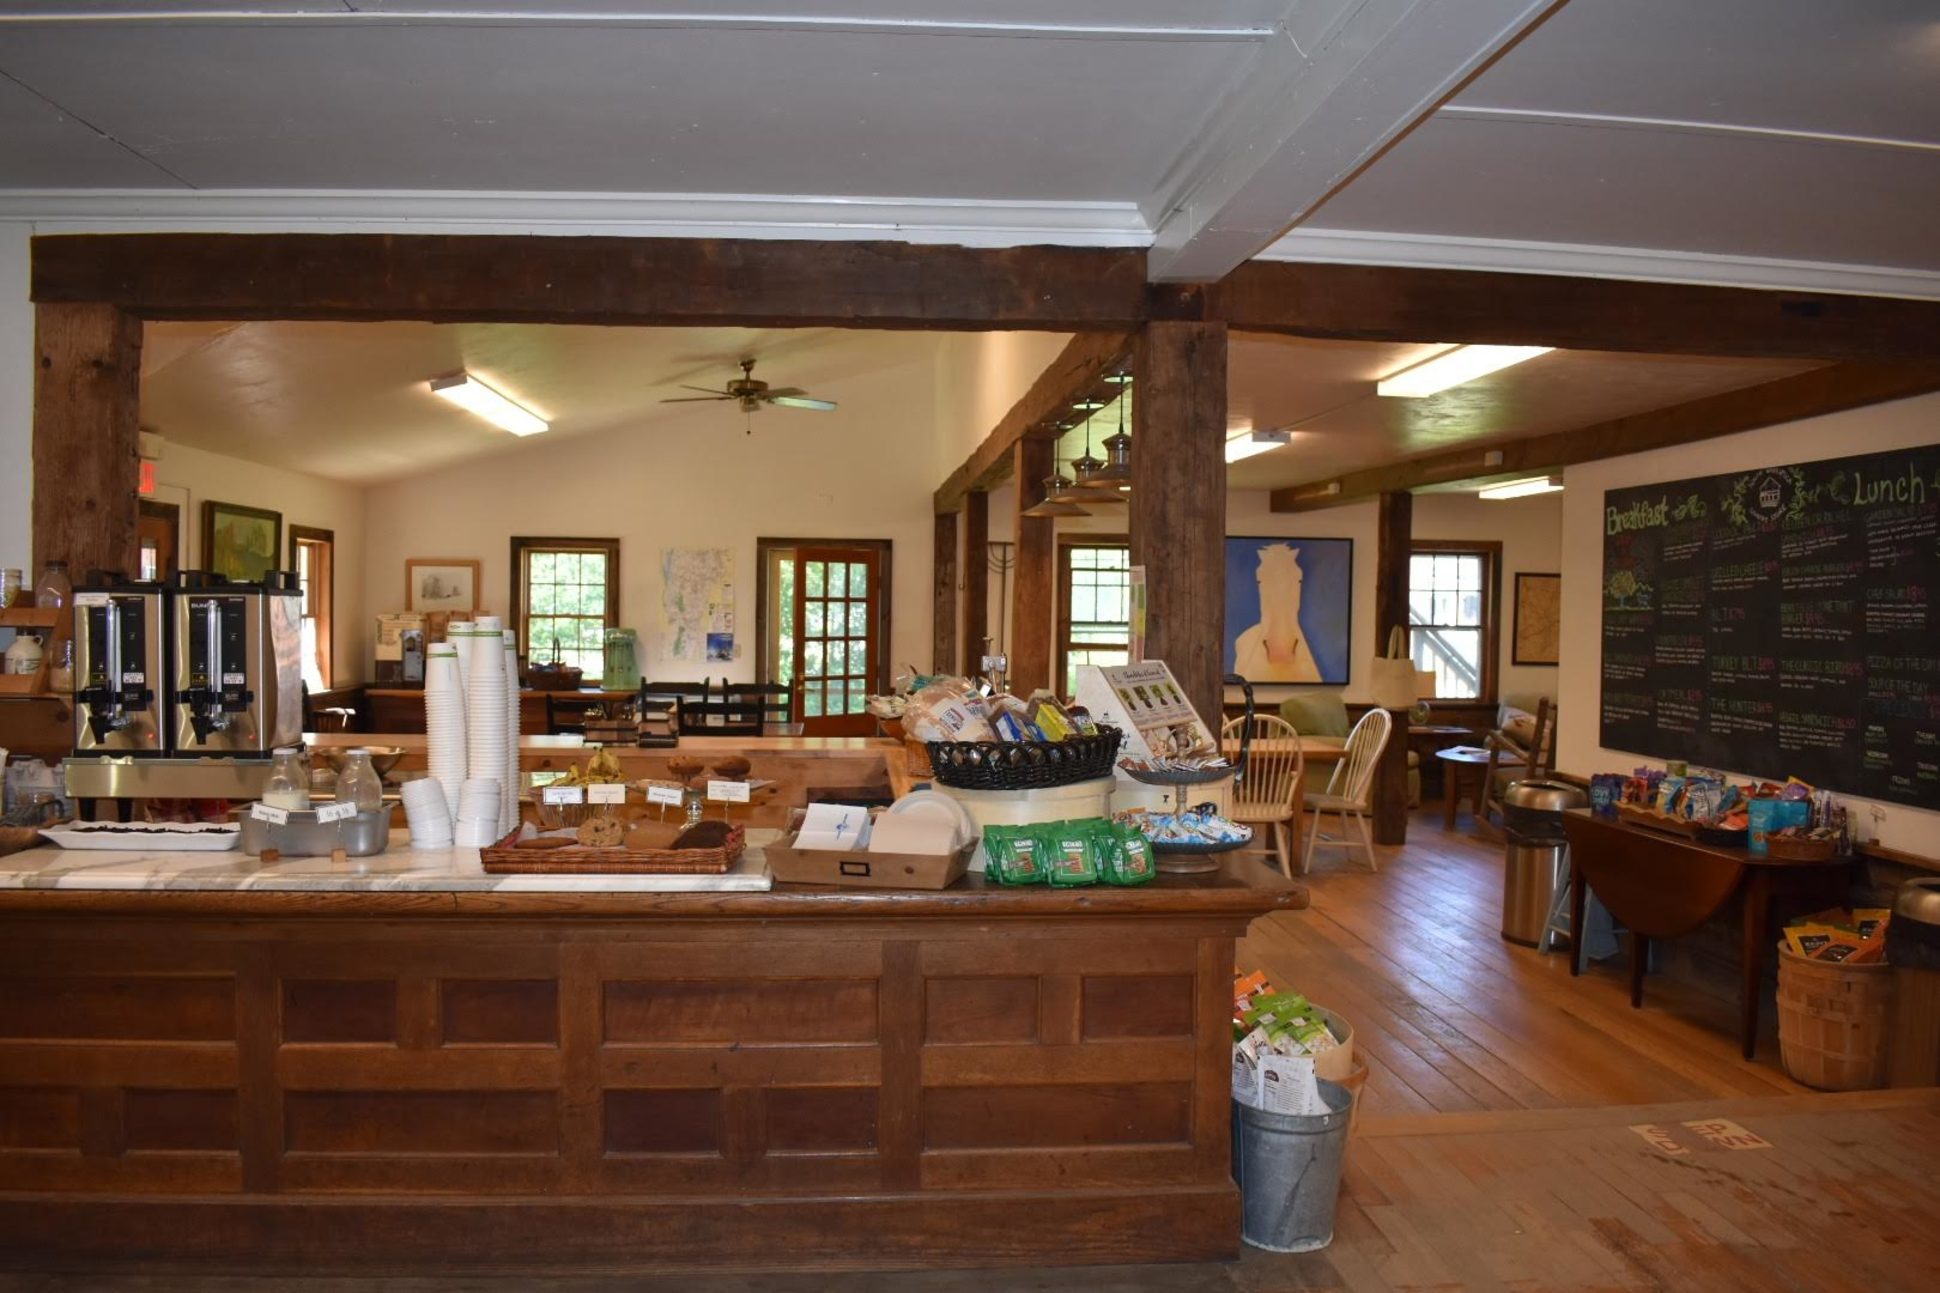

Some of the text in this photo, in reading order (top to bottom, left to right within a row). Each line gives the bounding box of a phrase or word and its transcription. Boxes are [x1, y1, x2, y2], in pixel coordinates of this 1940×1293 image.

[1853, 462, 1925, 506] Lunch
[1606, 494, 1670, 536] Breakfast
[1647, 1123, 1728, 1138] SEP
[1655, 1134, 1763, 1151] DWN
